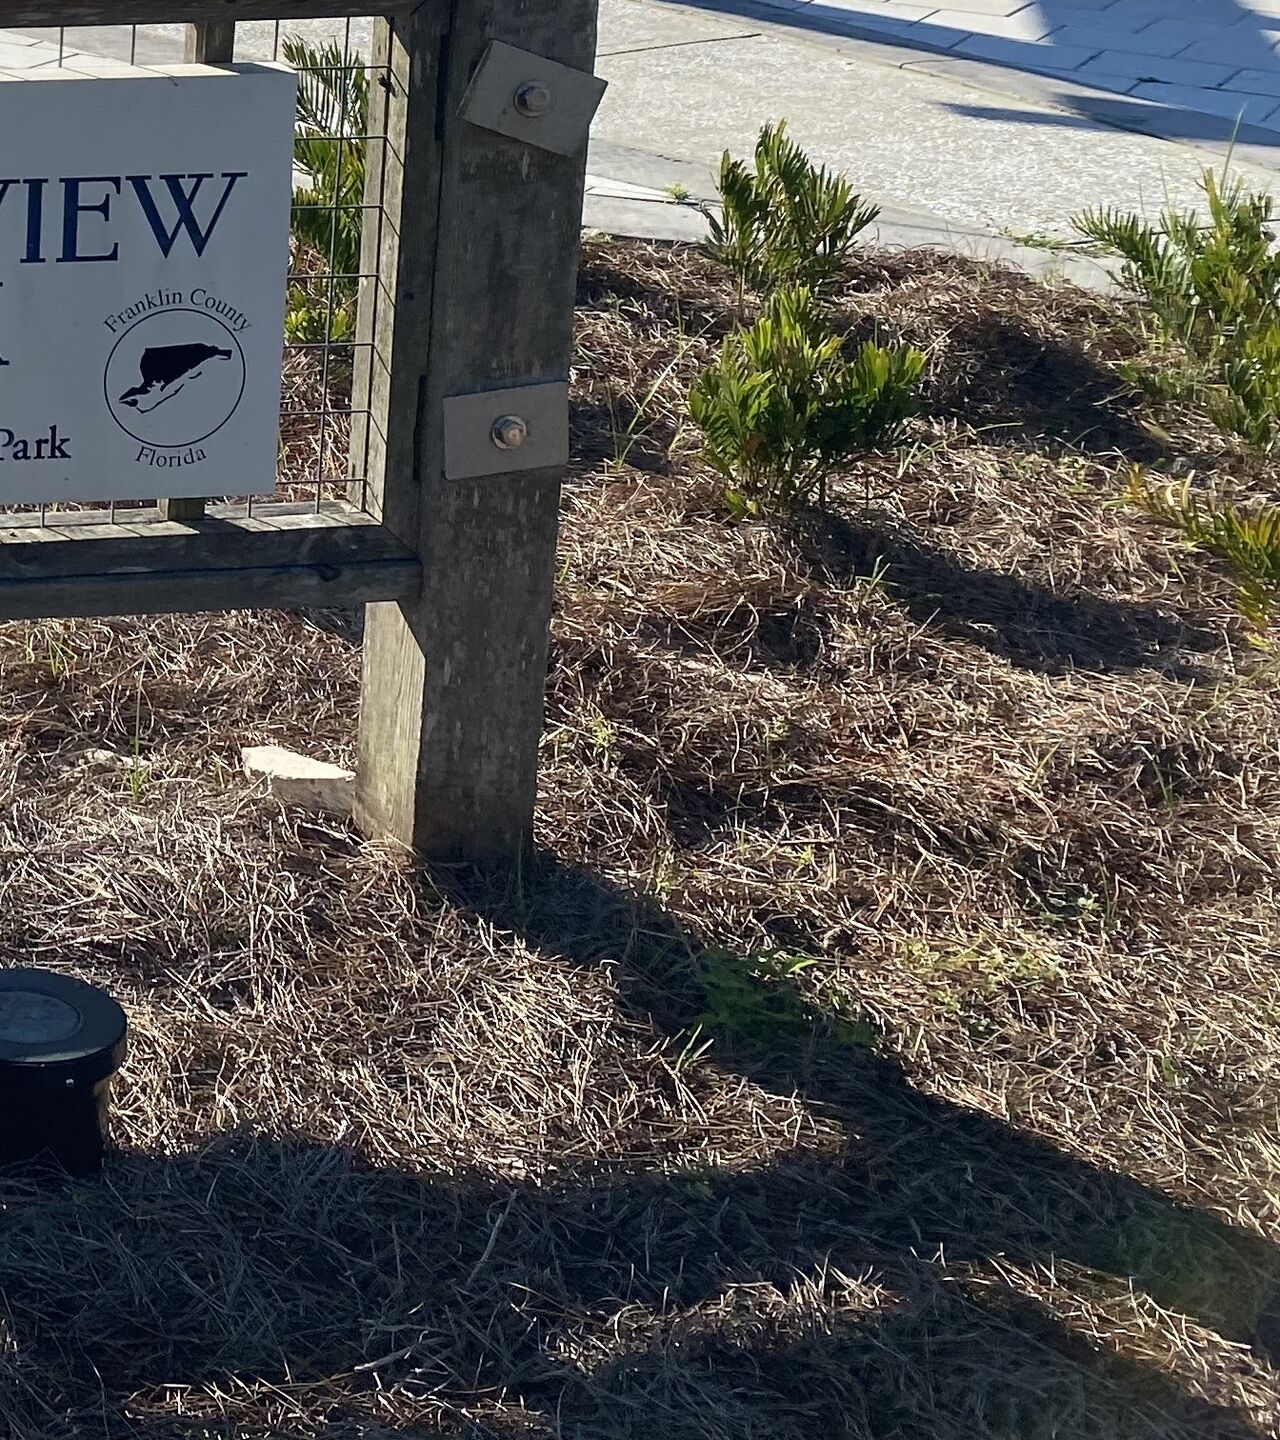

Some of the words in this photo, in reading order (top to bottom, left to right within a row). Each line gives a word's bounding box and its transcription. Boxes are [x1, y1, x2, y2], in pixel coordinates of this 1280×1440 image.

[103, 289, 183, 334] Franklin
[190, 288, 252, 334] County
[135, 446, 207, 467] Florida
